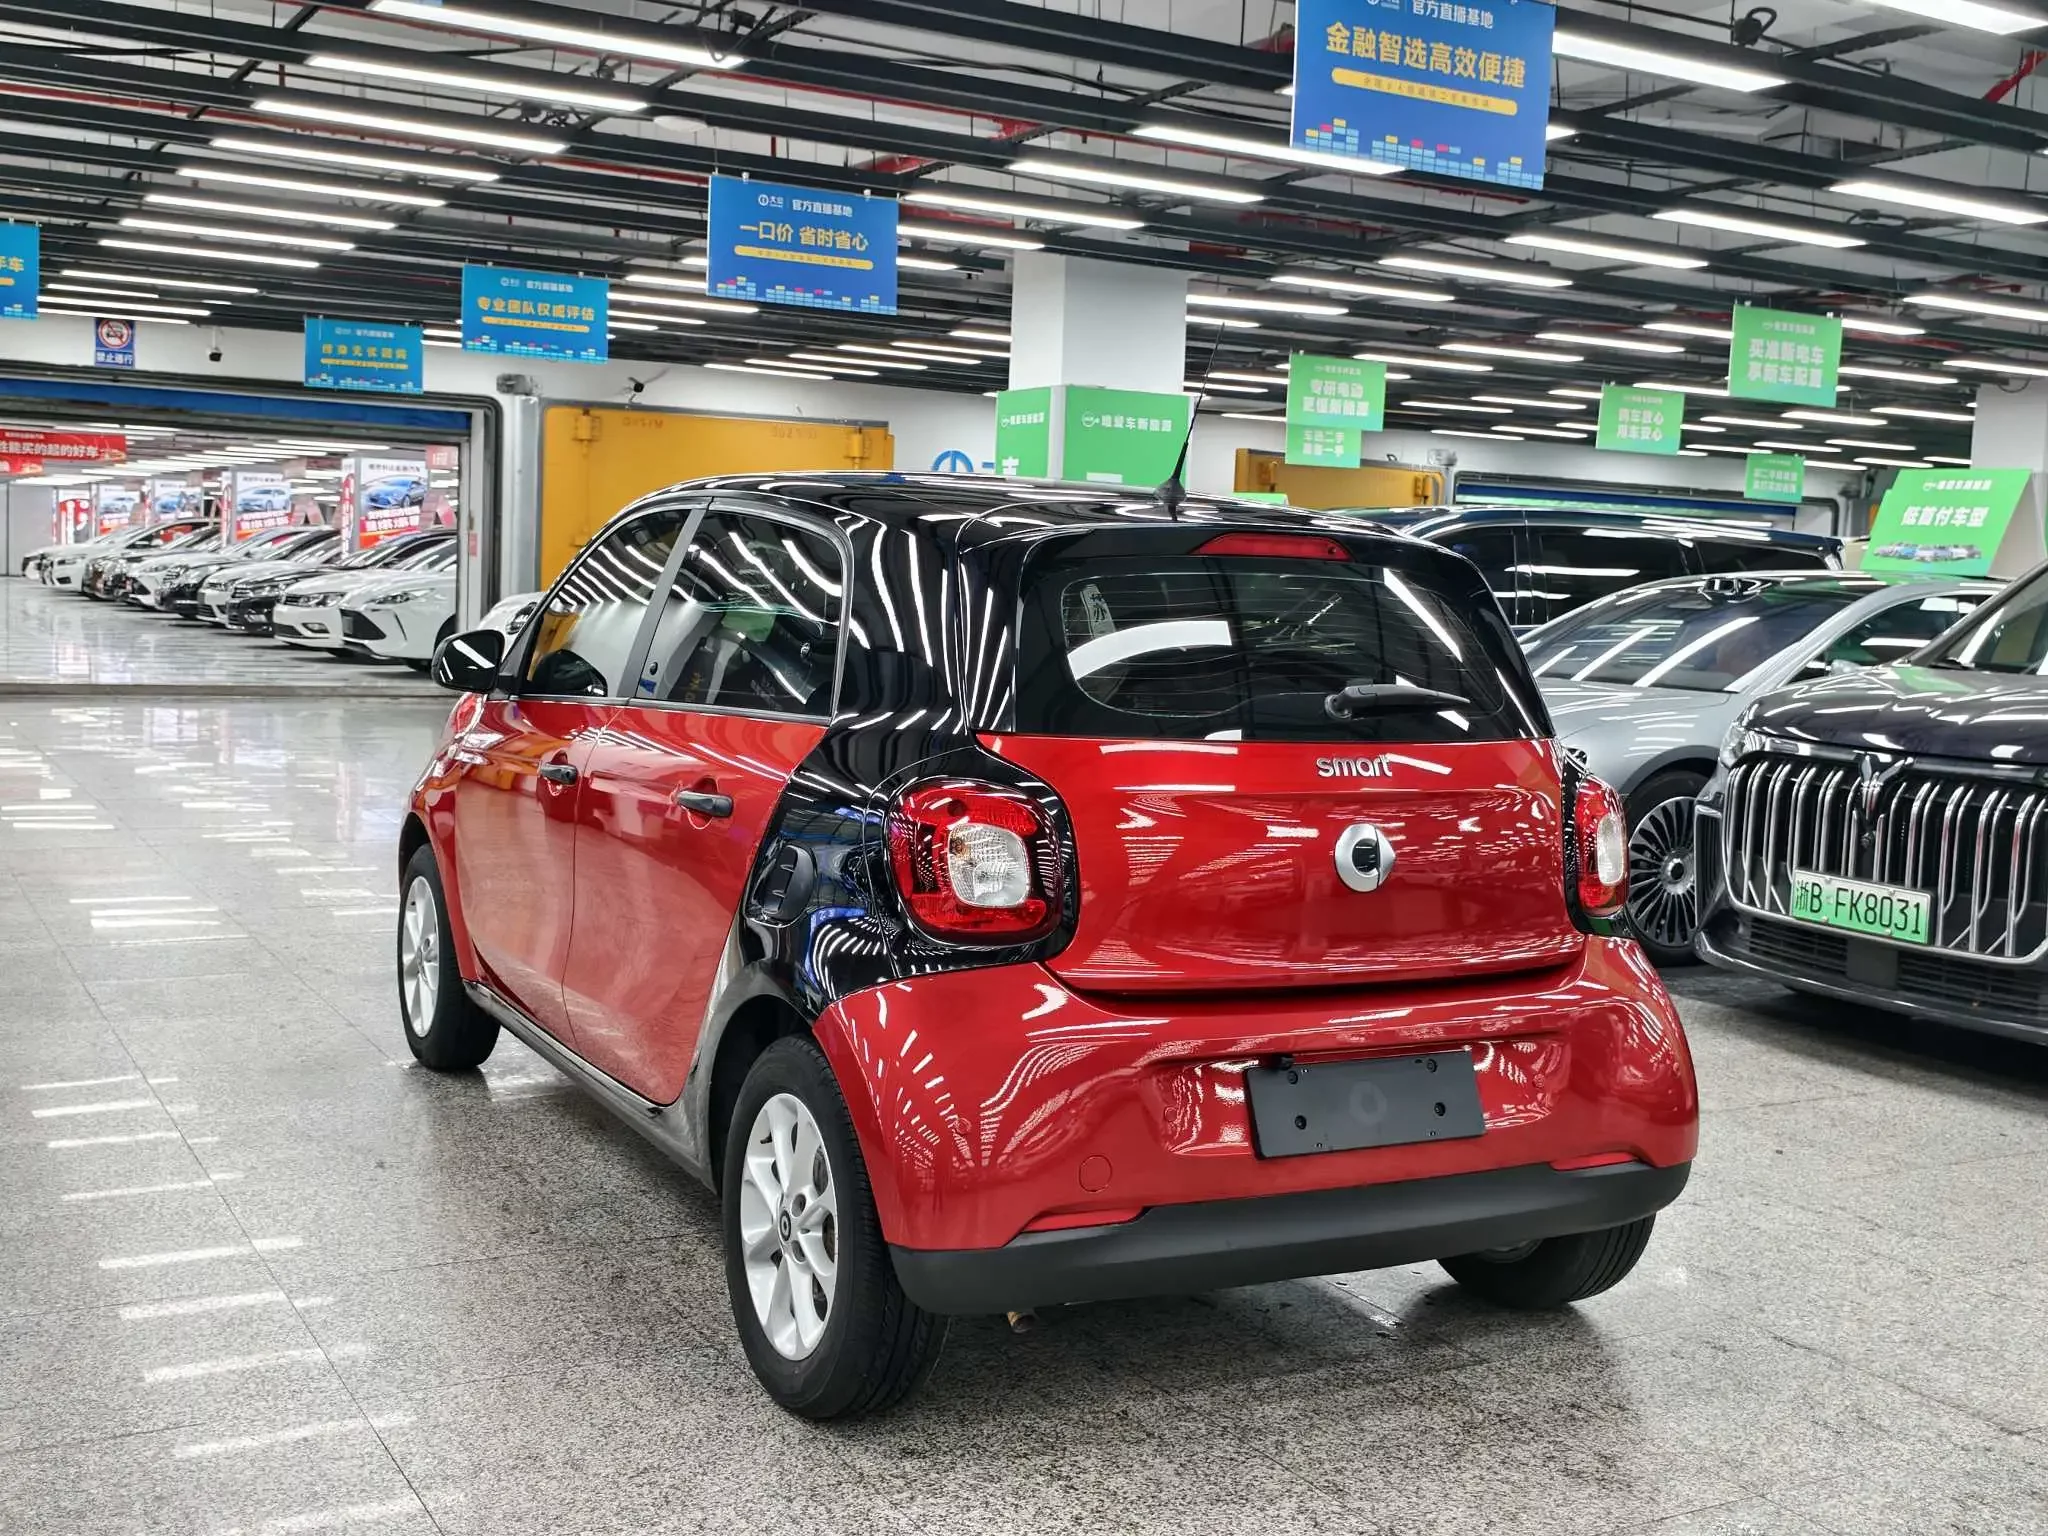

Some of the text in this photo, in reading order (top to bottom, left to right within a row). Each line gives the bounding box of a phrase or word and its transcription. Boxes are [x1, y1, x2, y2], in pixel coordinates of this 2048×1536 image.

[1413, 0, 1494, 29] 官方直播基地
[1326, 21, 1525, 89] 金融智选高效便捷
[739, 221, 869, 251] 一口价 省时省心
[477, 296, 595, 321] 专业团队权威评估
[1901, 506, 1989, 527] 低首付车型
[1316, 753, 1393, 777] smart
[1834, 887, 1921, 935] FK8031
